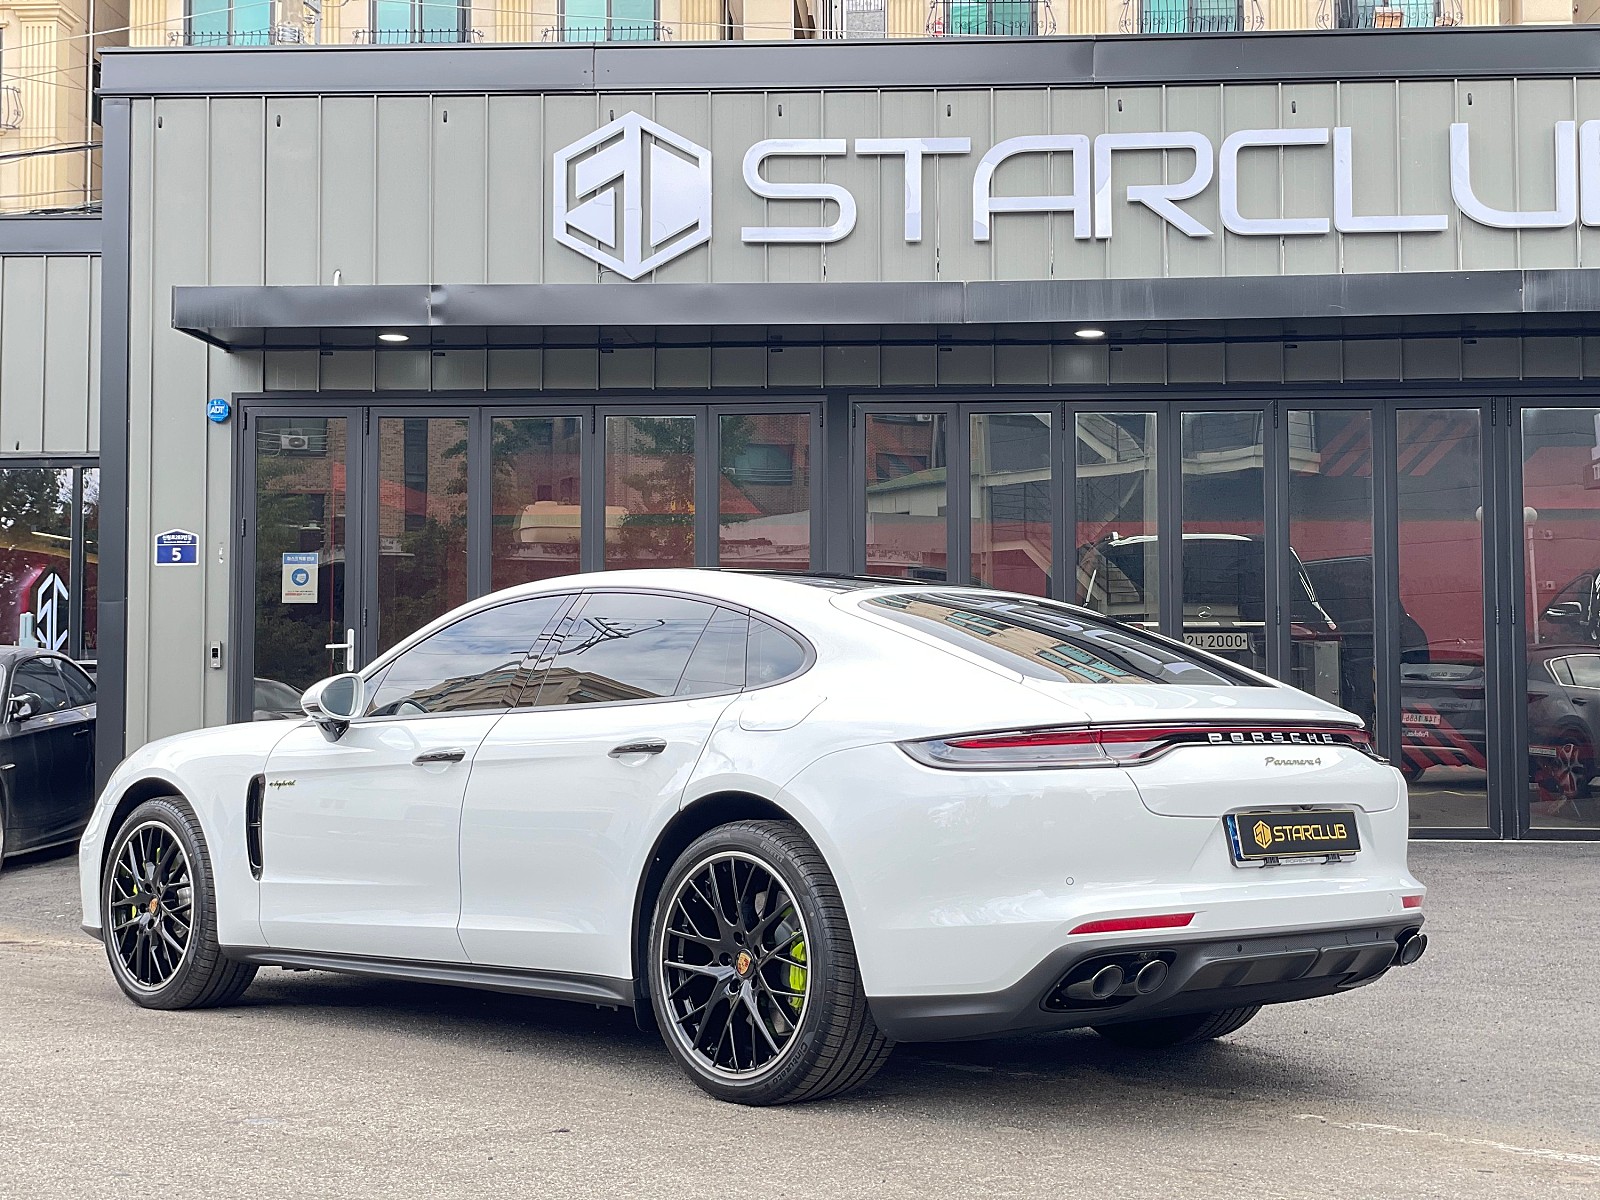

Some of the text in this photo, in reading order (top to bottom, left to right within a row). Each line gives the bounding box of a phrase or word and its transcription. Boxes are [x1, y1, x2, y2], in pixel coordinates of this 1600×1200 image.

[741, 119, 1600, 244] STARCLU
[210, 405, 225, 413] ADT
[171, 547, 182, 562] 5
[1207, 635, 1242, 647] 2000
[1207, 732, 1333, 744] PORSCHE
[1273, 823, 1348, 842] STARCLUB
[772, 1041, 809, 1085] Cinturato
